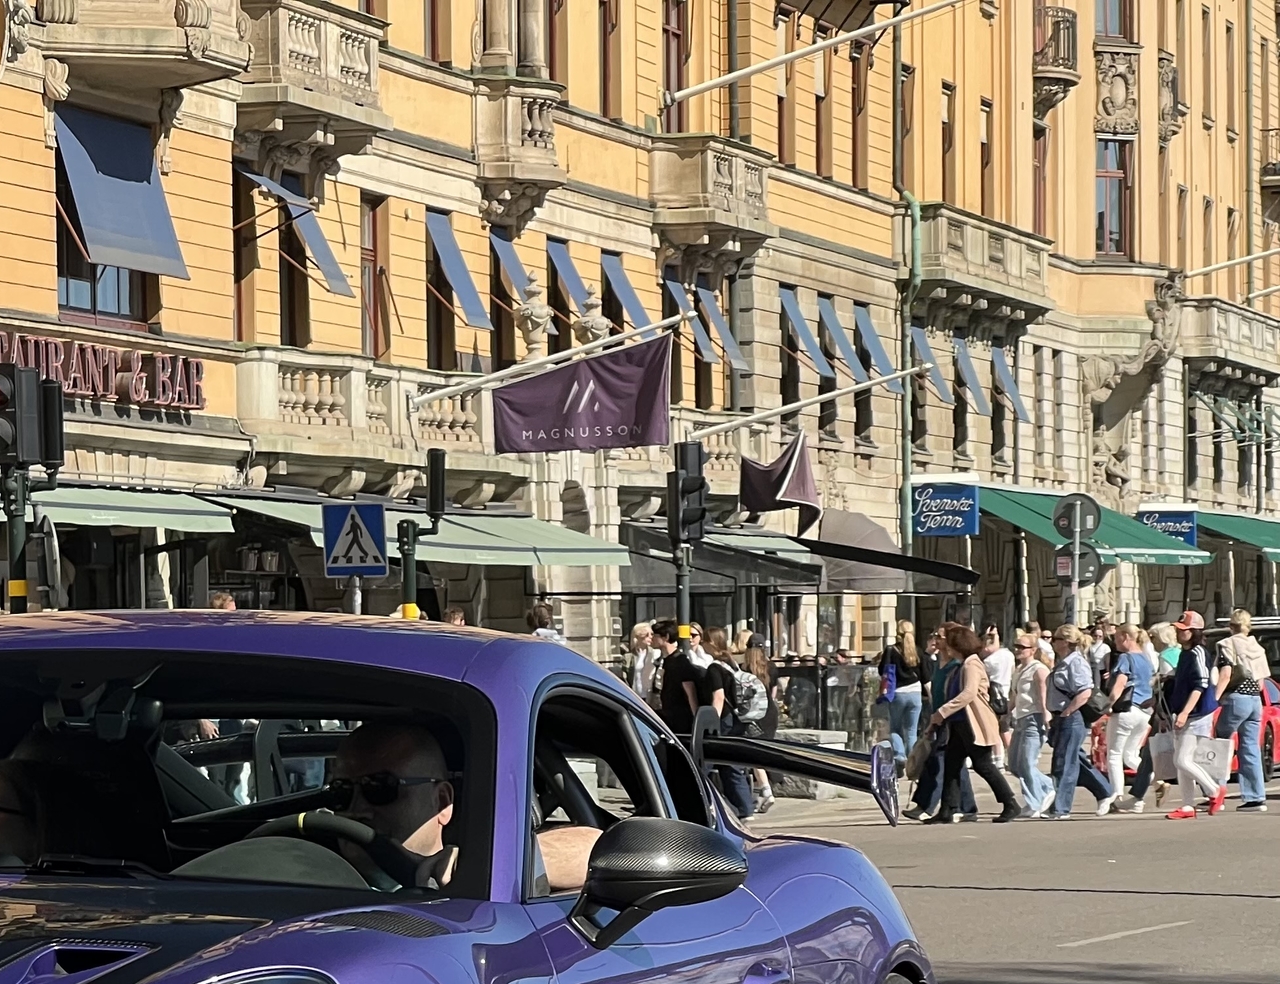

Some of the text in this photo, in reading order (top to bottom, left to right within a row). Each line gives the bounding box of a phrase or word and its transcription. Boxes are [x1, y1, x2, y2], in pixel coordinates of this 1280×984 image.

[128, 349, 150, 403] &
[153, 351, 207, 410] BAR
[522, 424, 642, 441] MAGNUSSON
[911, 488, 974, 516] Svenskt
[917, 511, 965, 532] Tenn
